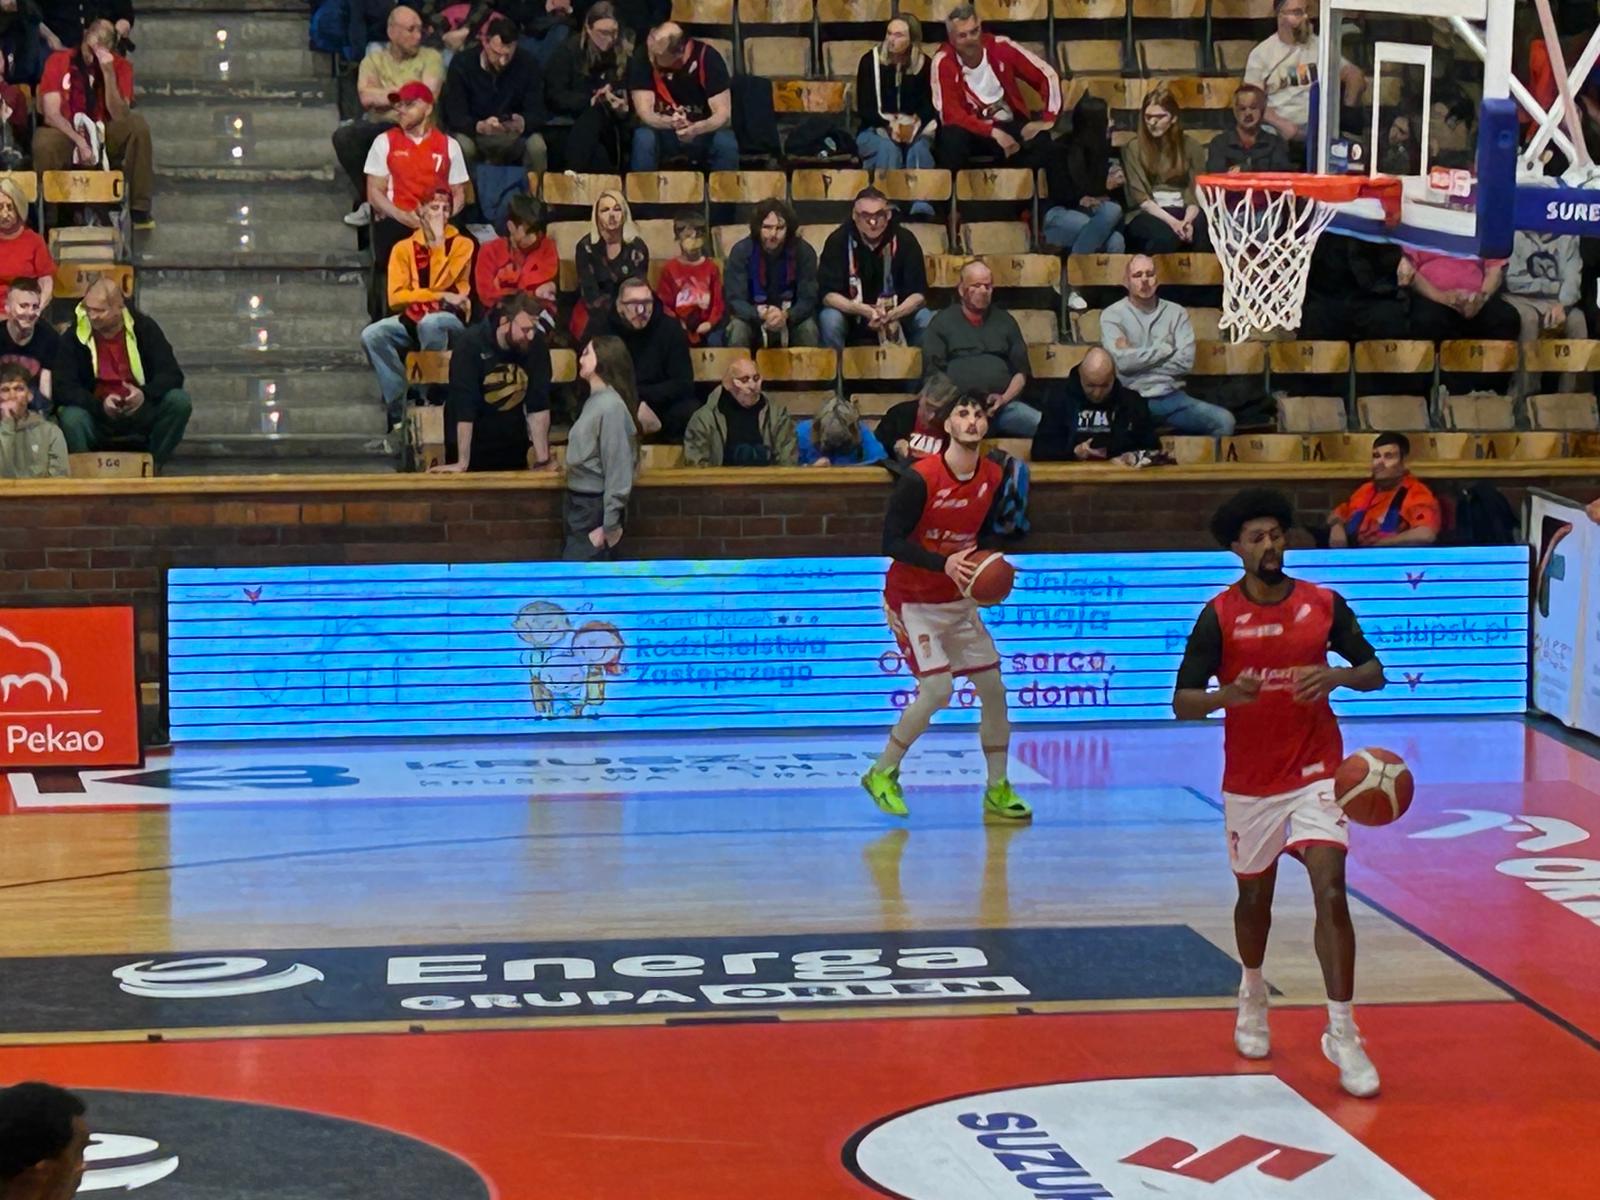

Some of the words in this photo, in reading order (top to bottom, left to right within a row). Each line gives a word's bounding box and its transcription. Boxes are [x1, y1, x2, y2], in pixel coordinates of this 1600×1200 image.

[432, 153, 443, 173] 7
[7, 723, 105, 754] Pekao
[386, 944, 990, 985] Energa
[400, 986, 696, 1012] GRUPA
[722, 978, 1004, 1000] ORLEN
